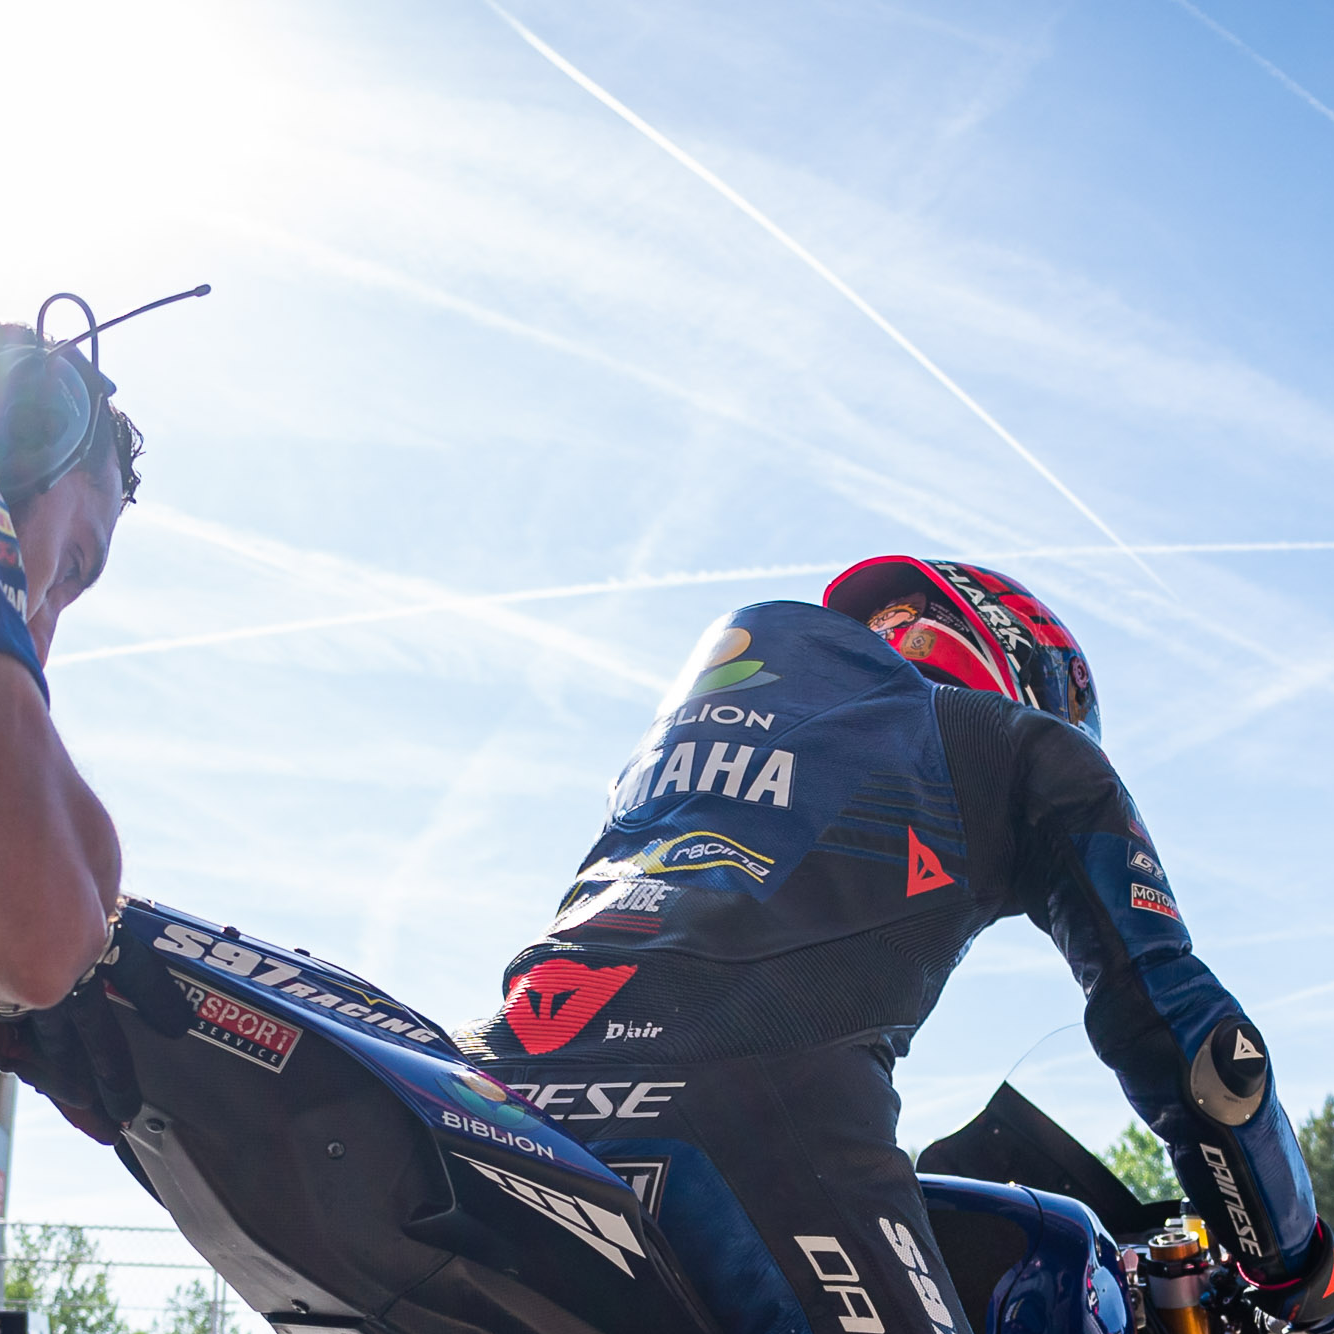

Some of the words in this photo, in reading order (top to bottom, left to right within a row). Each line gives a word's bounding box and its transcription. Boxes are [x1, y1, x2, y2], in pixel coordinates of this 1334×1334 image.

[931, 560, 1033, 650] HARK
[672, 842, 771, 877] racing
[153, 924, 302, 986] S97
[281, 982, 439, 1044] RACING
[197, 1020, 280, 1064] SERVICE
[442, 1110, 554, 1160] BIBLION
[1199, 1143, 1262, 1258] DAINESE
